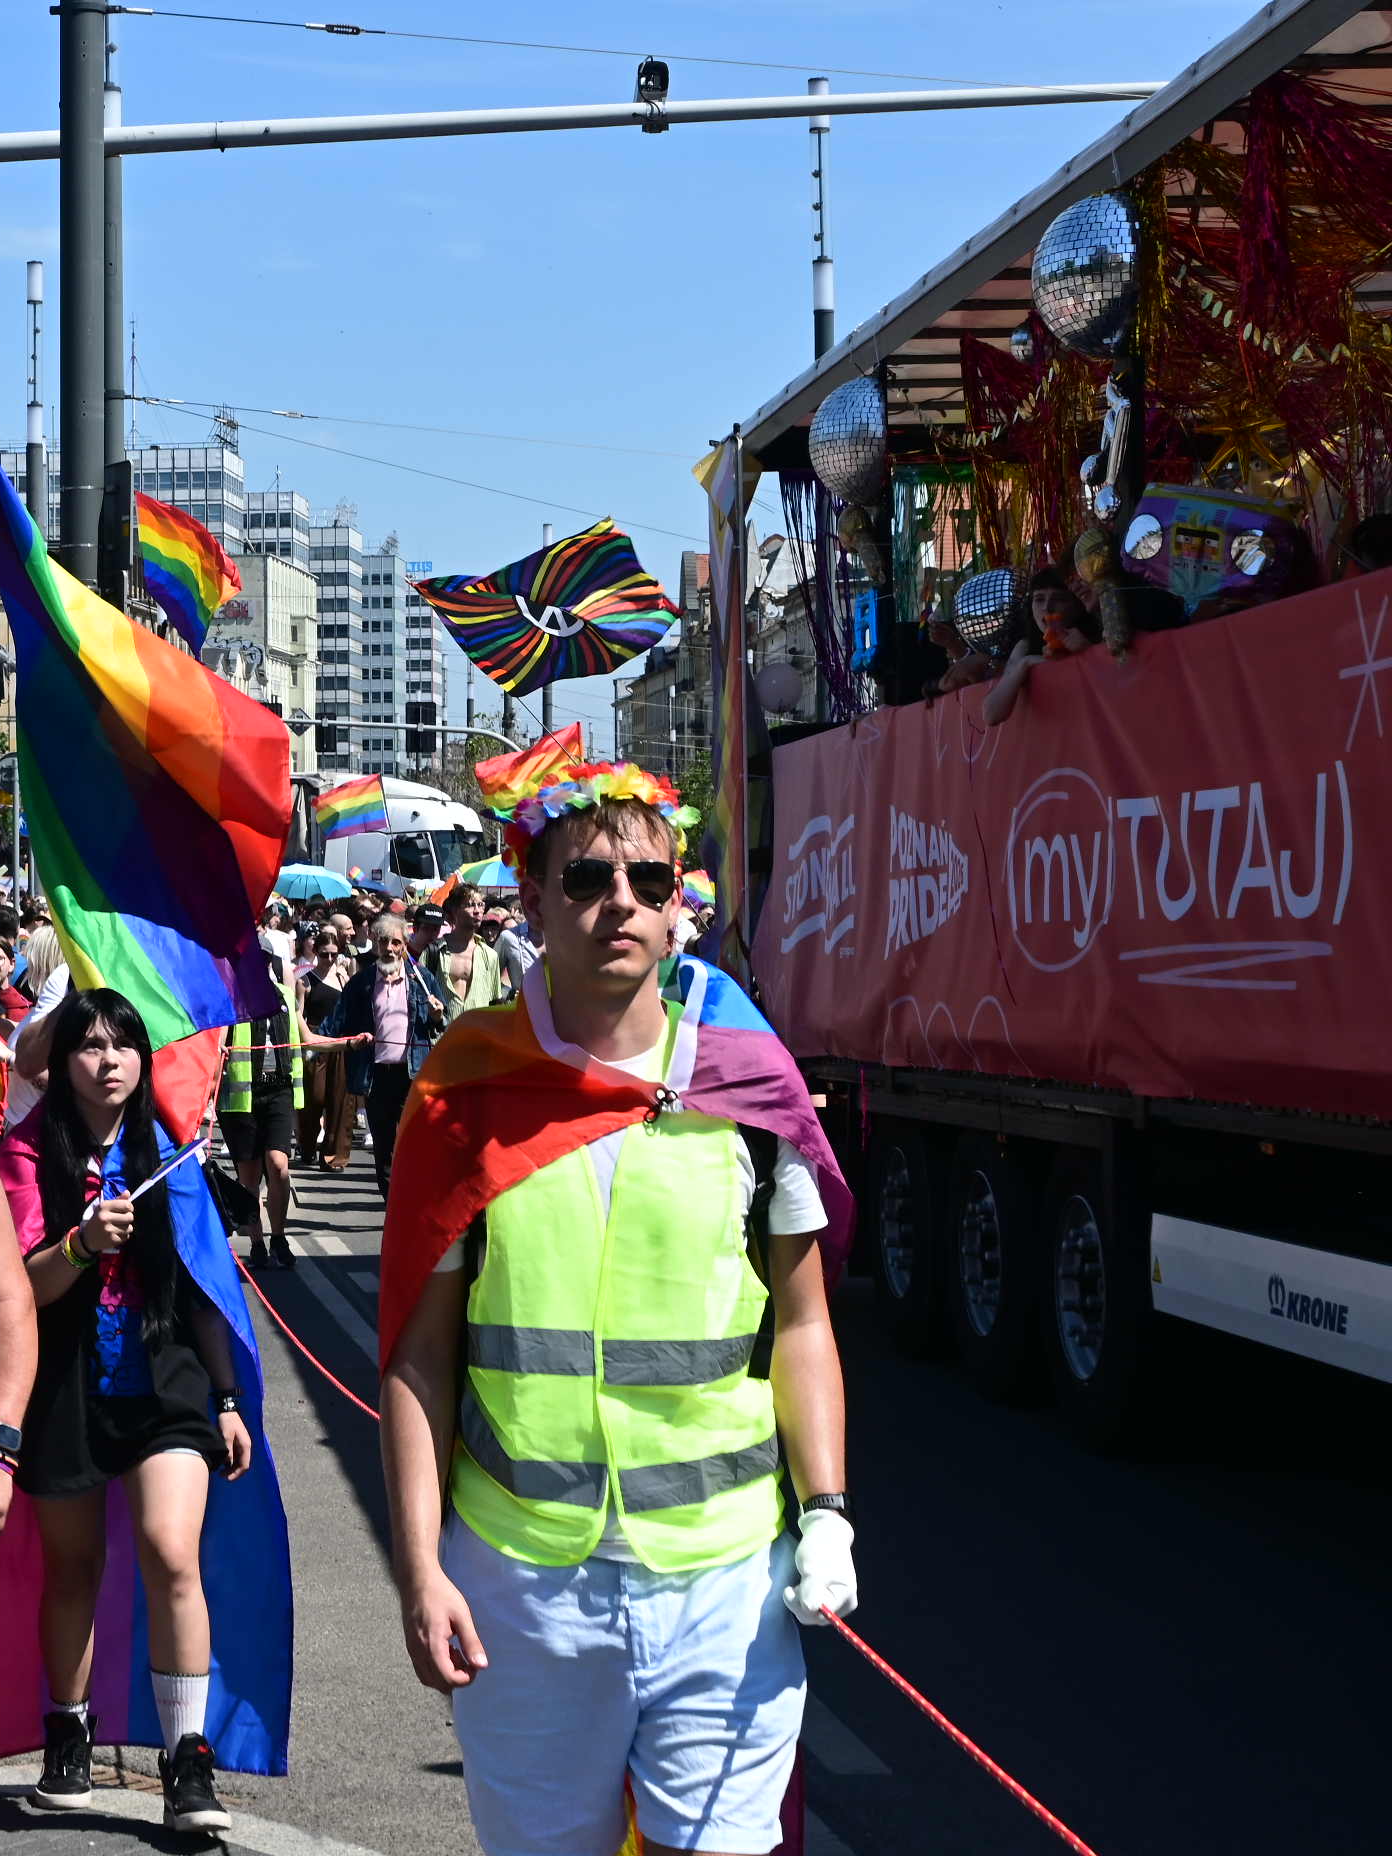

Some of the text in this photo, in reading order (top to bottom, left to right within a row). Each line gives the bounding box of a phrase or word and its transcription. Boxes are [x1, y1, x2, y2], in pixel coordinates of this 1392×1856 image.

[890, 804, 950, 872] POZNAŃ
[884, 874, 949, 960] PRIDE
[1286, 1290, 1349, 1335] KRONE
